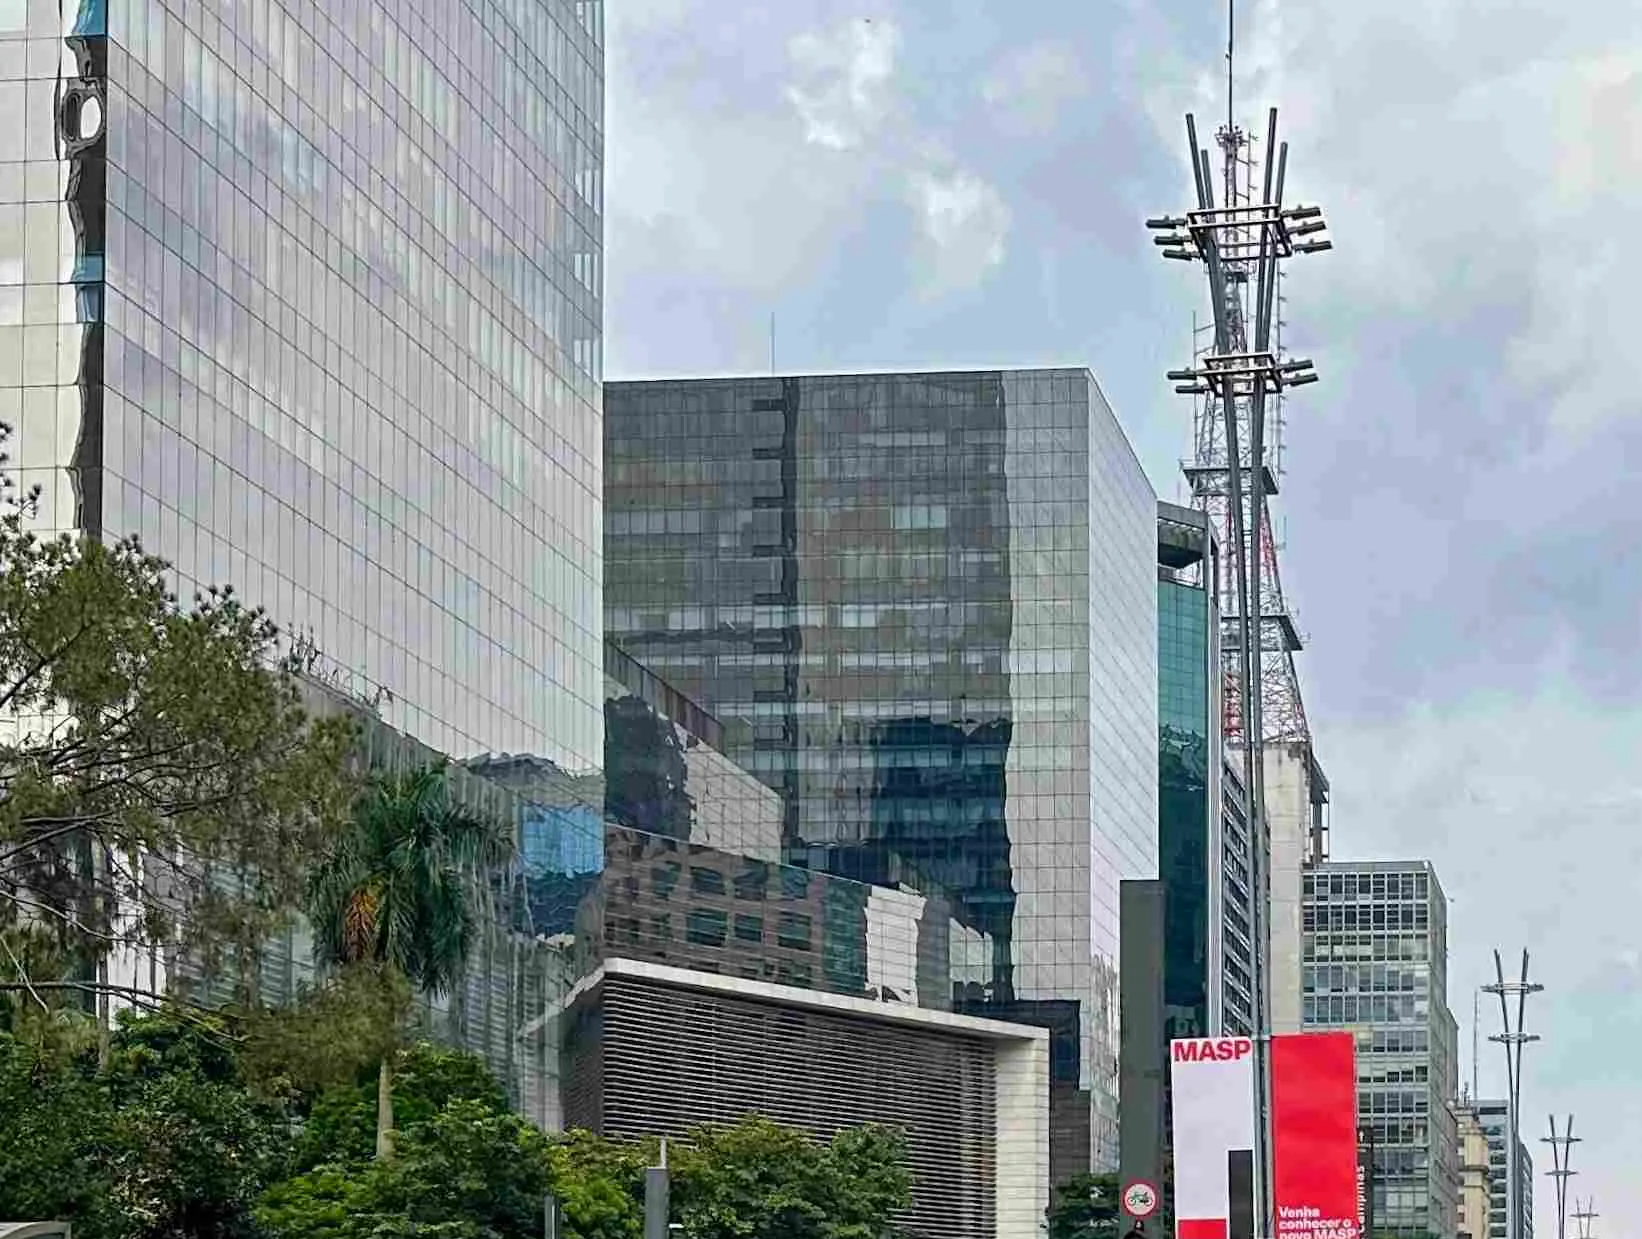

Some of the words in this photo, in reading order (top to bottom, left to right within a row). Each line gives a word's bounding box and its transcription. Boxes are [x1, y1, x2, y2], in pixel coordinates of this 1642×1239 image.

[1174, 1040, 1250, 1061] MASP
[1279, 1206, 1320, 1218] Venha
[1279, 1219, 1341, 1230] conhecer
